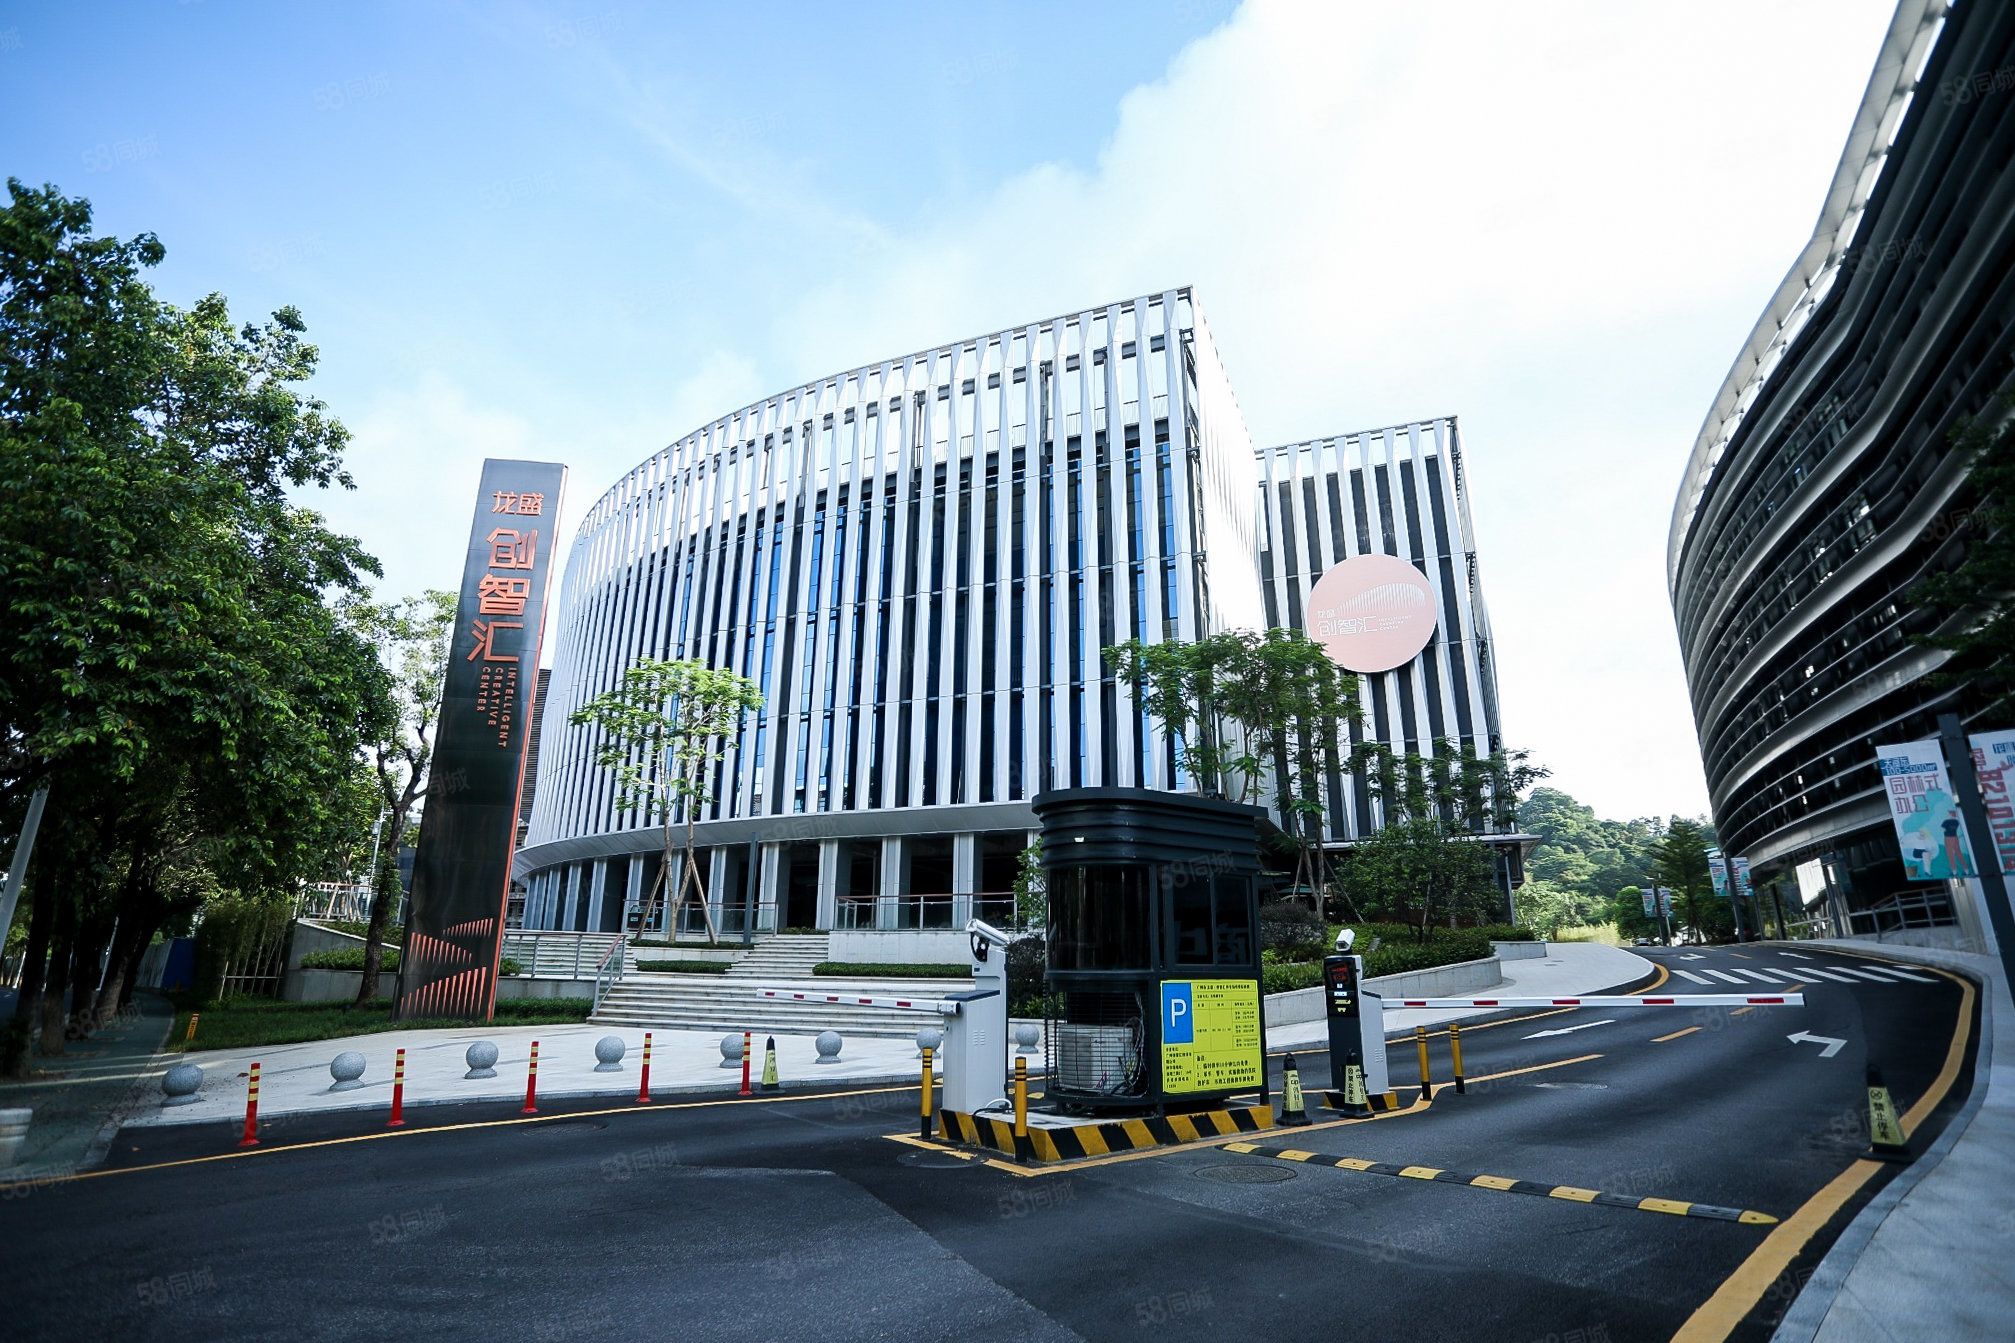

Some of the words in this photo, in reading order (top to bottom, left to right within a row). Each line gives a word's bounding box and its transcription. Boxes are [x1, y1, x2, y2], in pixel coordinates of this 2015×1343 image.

[491, 490, 543, 516] 龙盛
[467, 527, 538, 663] 创智汇
[1317, 615, 1377, 637] 创智汇
[475, 666, 491, 712] CENTER
[487, 667, 503, 727] CREATIVE
[498, 667, 517, 749] INTELLIGENT
[1171, 998, 1187, 1028] P
